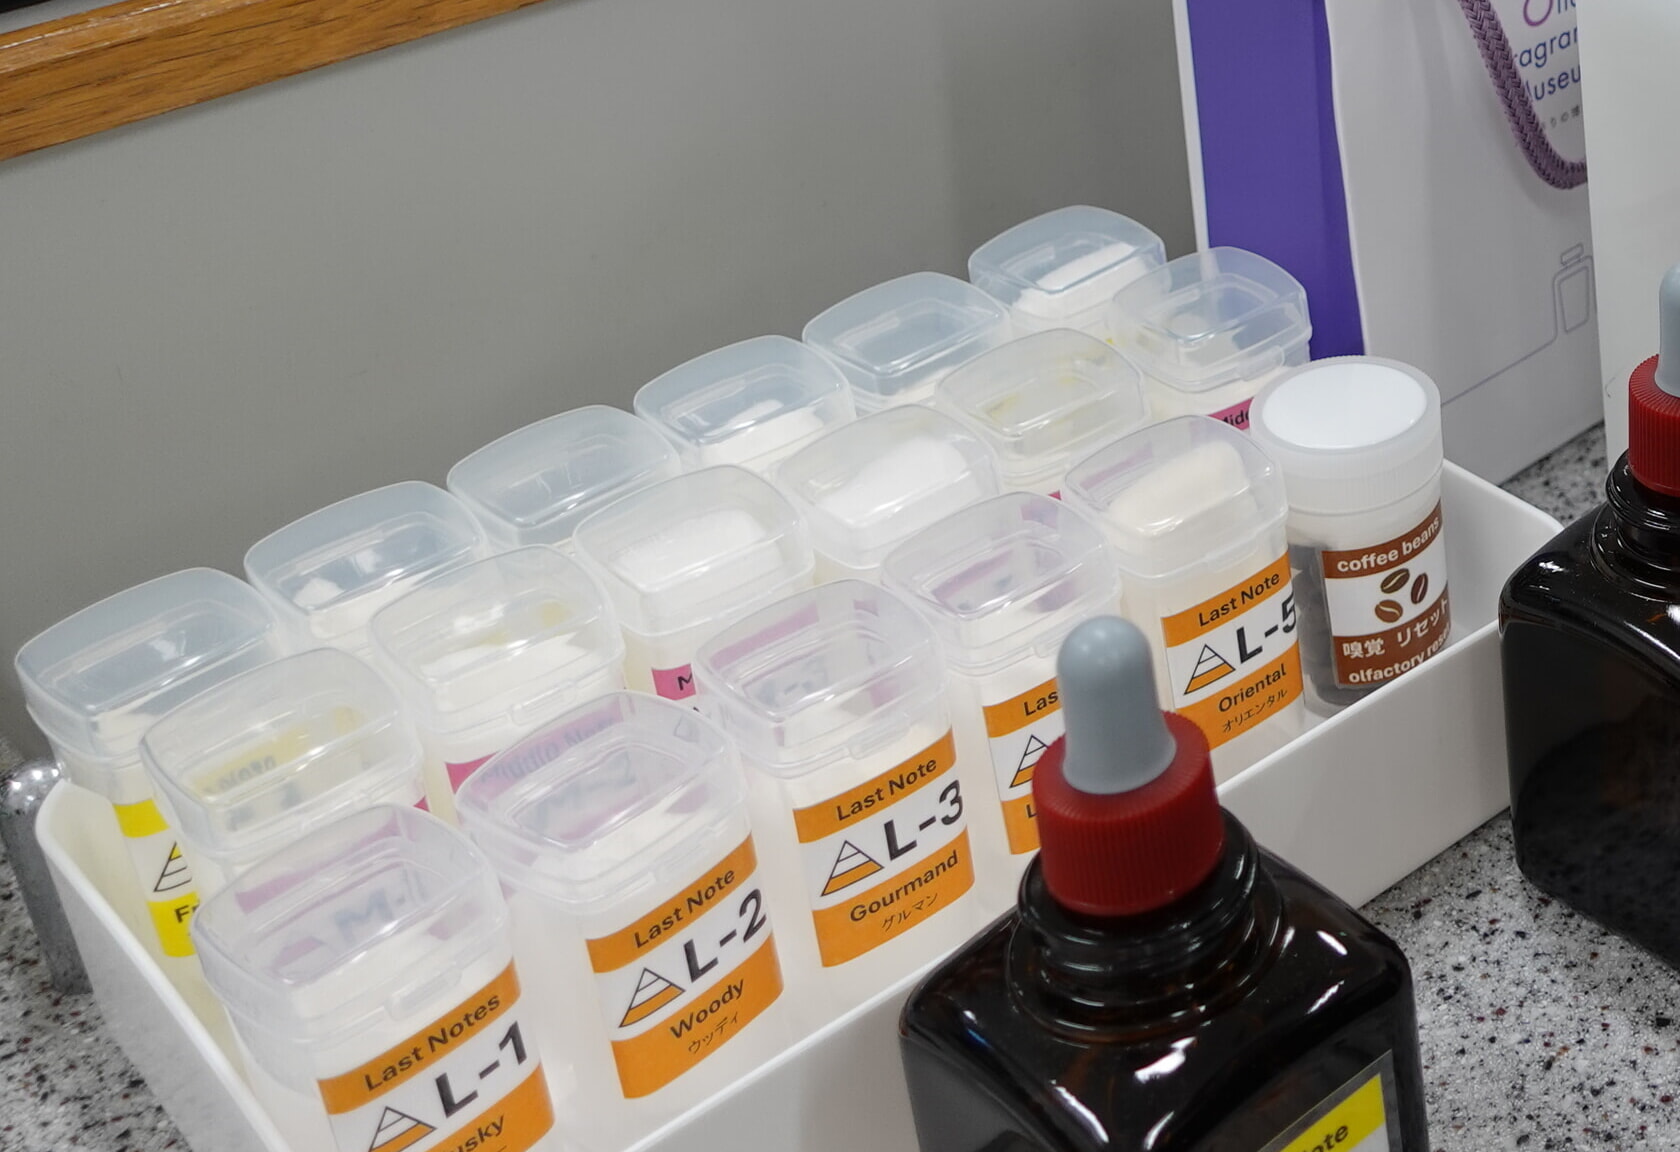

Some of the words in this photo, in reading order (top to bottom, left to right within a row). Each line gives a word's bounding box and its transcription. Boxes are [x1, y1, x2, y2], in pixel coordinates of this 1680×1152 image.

[1337, 549, 1399, 572] coffee
[1402, 516, 1440, 555] beans
[1198, 597, 1237, 627] Last
[1240, 573, 1280, 604] Note
[1236, 591, 1296, 664] L-5
[1397, 598, 1448, 648] リセット
[1218, 663, 1287, 713] Oriental
[1349, 651, 1425, 683] olfactory
[1024, 690, 1059, 716] Las
[1222, 689, 1288, 734] オリエンタル
[836, 788, 885, 821] Last
[888, 759, 937, 796] Note
[884, 779, 963, 862] L-3
[634, 908, 684, 949] Last
[687, 869, 736, 914] Note
[850, 849, 959, 922] Gourmand
[881, 893, 938, 933] グルマン
[683, 888, 767, 983] L-2
[669, 979, 745, 1039] Woody
[687, 1011, 739, 1055] ウッディ
[364, 1046, 424, 1093] Last
[427, 994, 501, 1053] Notes
[435, 1020, 528, 1119] L-1
